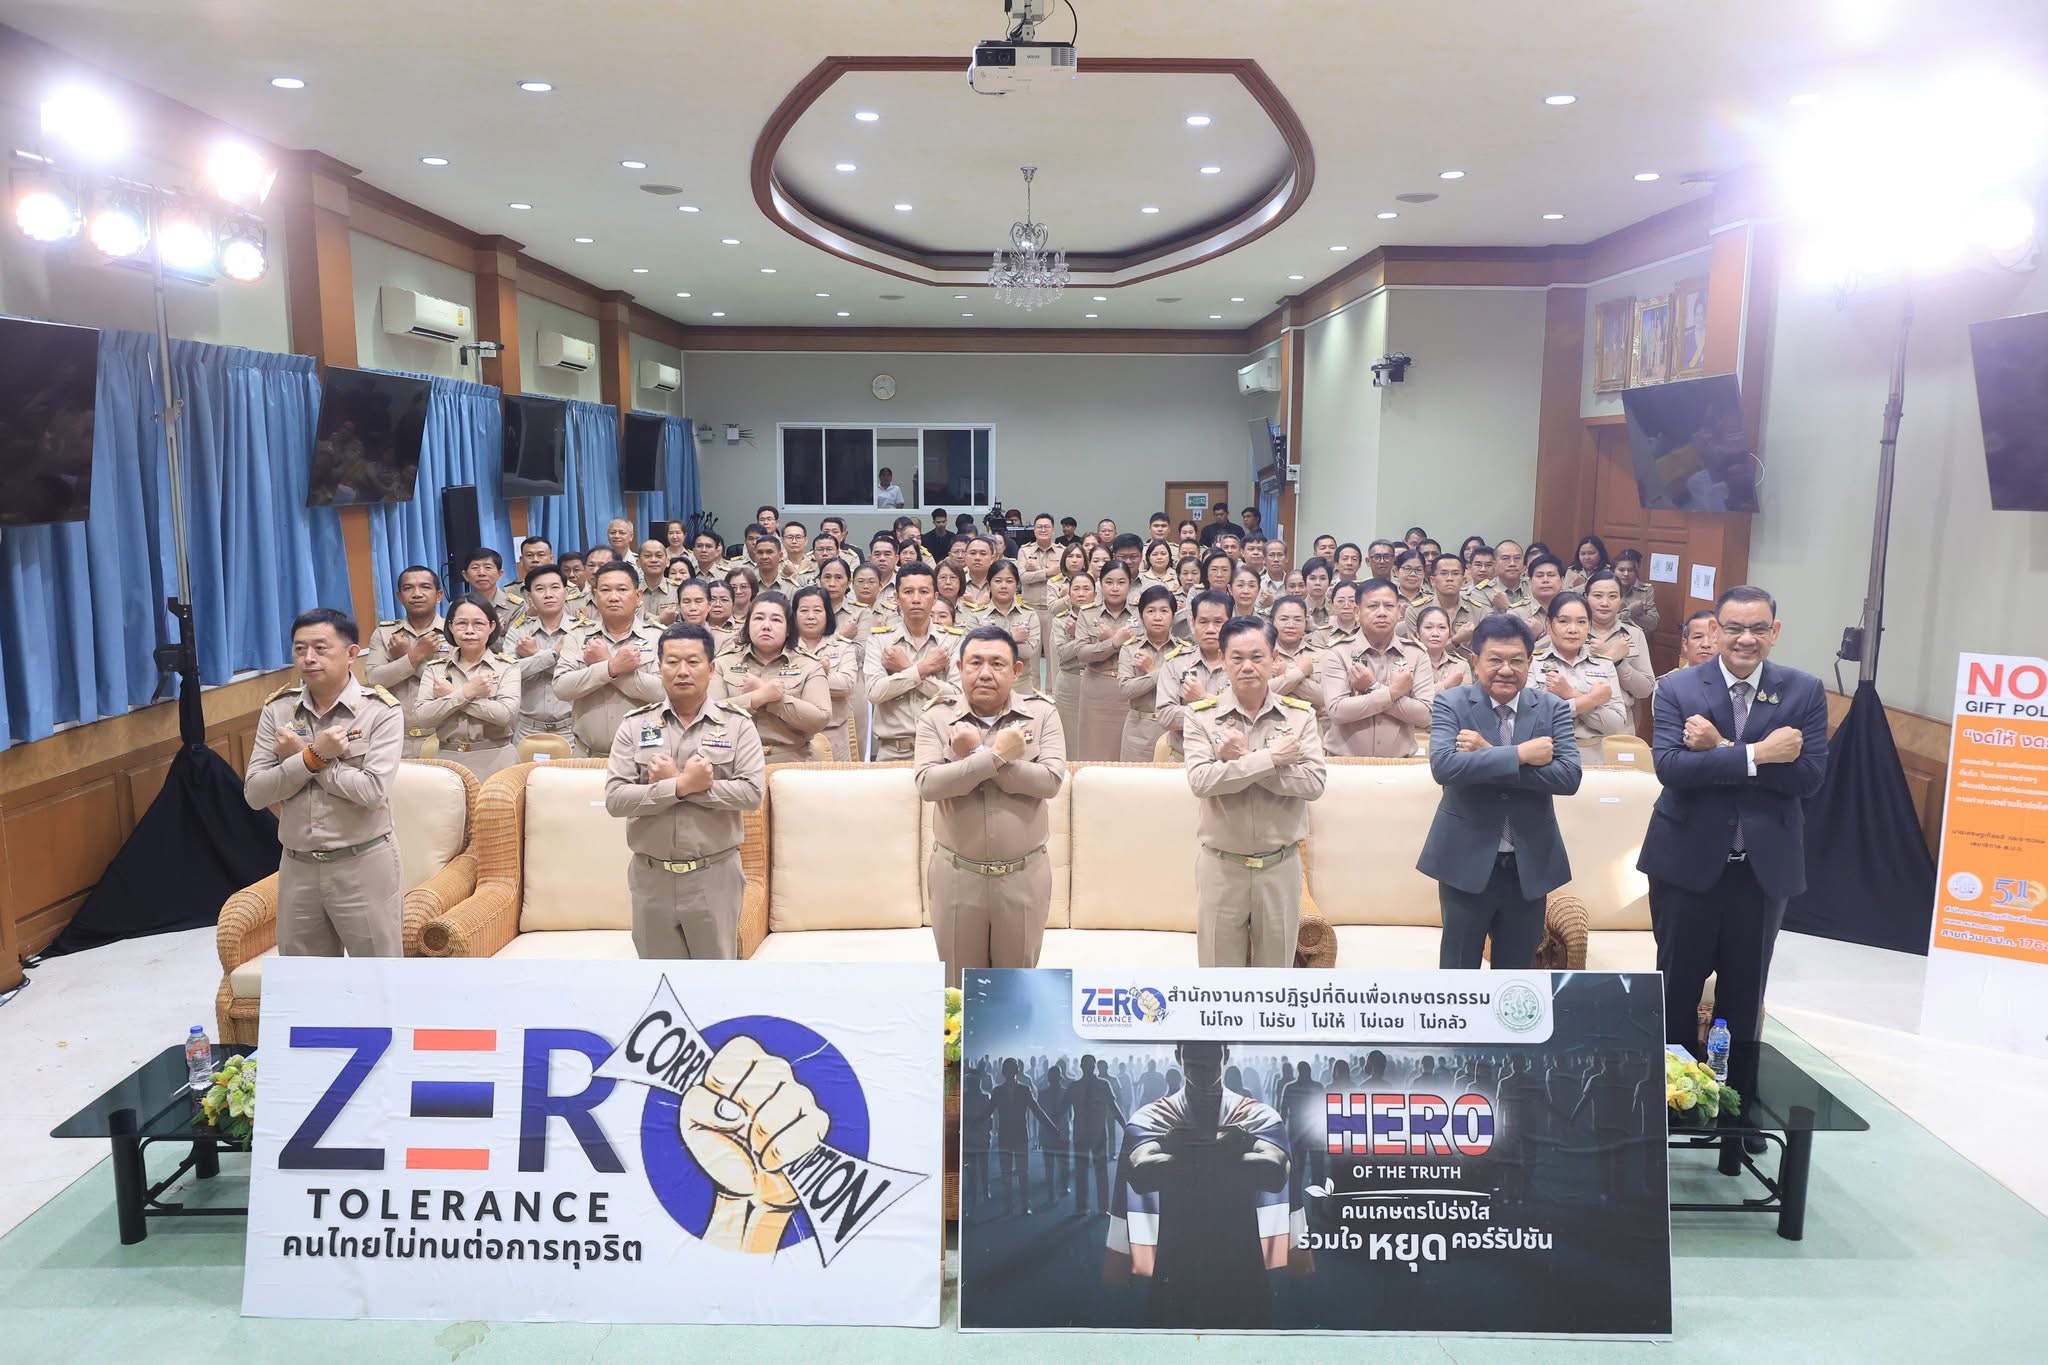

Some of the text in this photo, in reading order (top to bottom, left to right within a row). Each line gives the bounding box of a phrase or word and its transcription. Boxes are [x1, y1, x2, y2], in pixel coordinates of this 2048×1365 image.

[1967, 662, 2048, 700] NO
[1965, 700, 2006, 714] GIFT
[2021, 735, 2048, 748] งด
[1942, 929, 1982, 941] สายด่วน
[1168, 983, 1490, 1008] สำนักงานการปฏิรูปที่ดินเพื่อเกษตรกรรม
[1081, 1015, 1132, 1023] TOLERANCE
[1200, 1011, 1467, 1029] ไม่โกง ไม่รับ ไม่ให้ ไม่เฉย ไม่กลัว
[1326, 1093, 1495, 1156] HERO
[1353, 1165, 1461, 1179] OF THE TRUTH
[307, 1188, 609, 1223] TOLERANCE
[1342, 1200, 1490, 1220] คนเกษตรโปร่งใส
[283, 1227, 642, 1270] คนไทยไม่ทนต่อการทุจริต
[1297, 1225, 1553, 1272] ร่วมใจ หยุด คอร์รัปชัน
